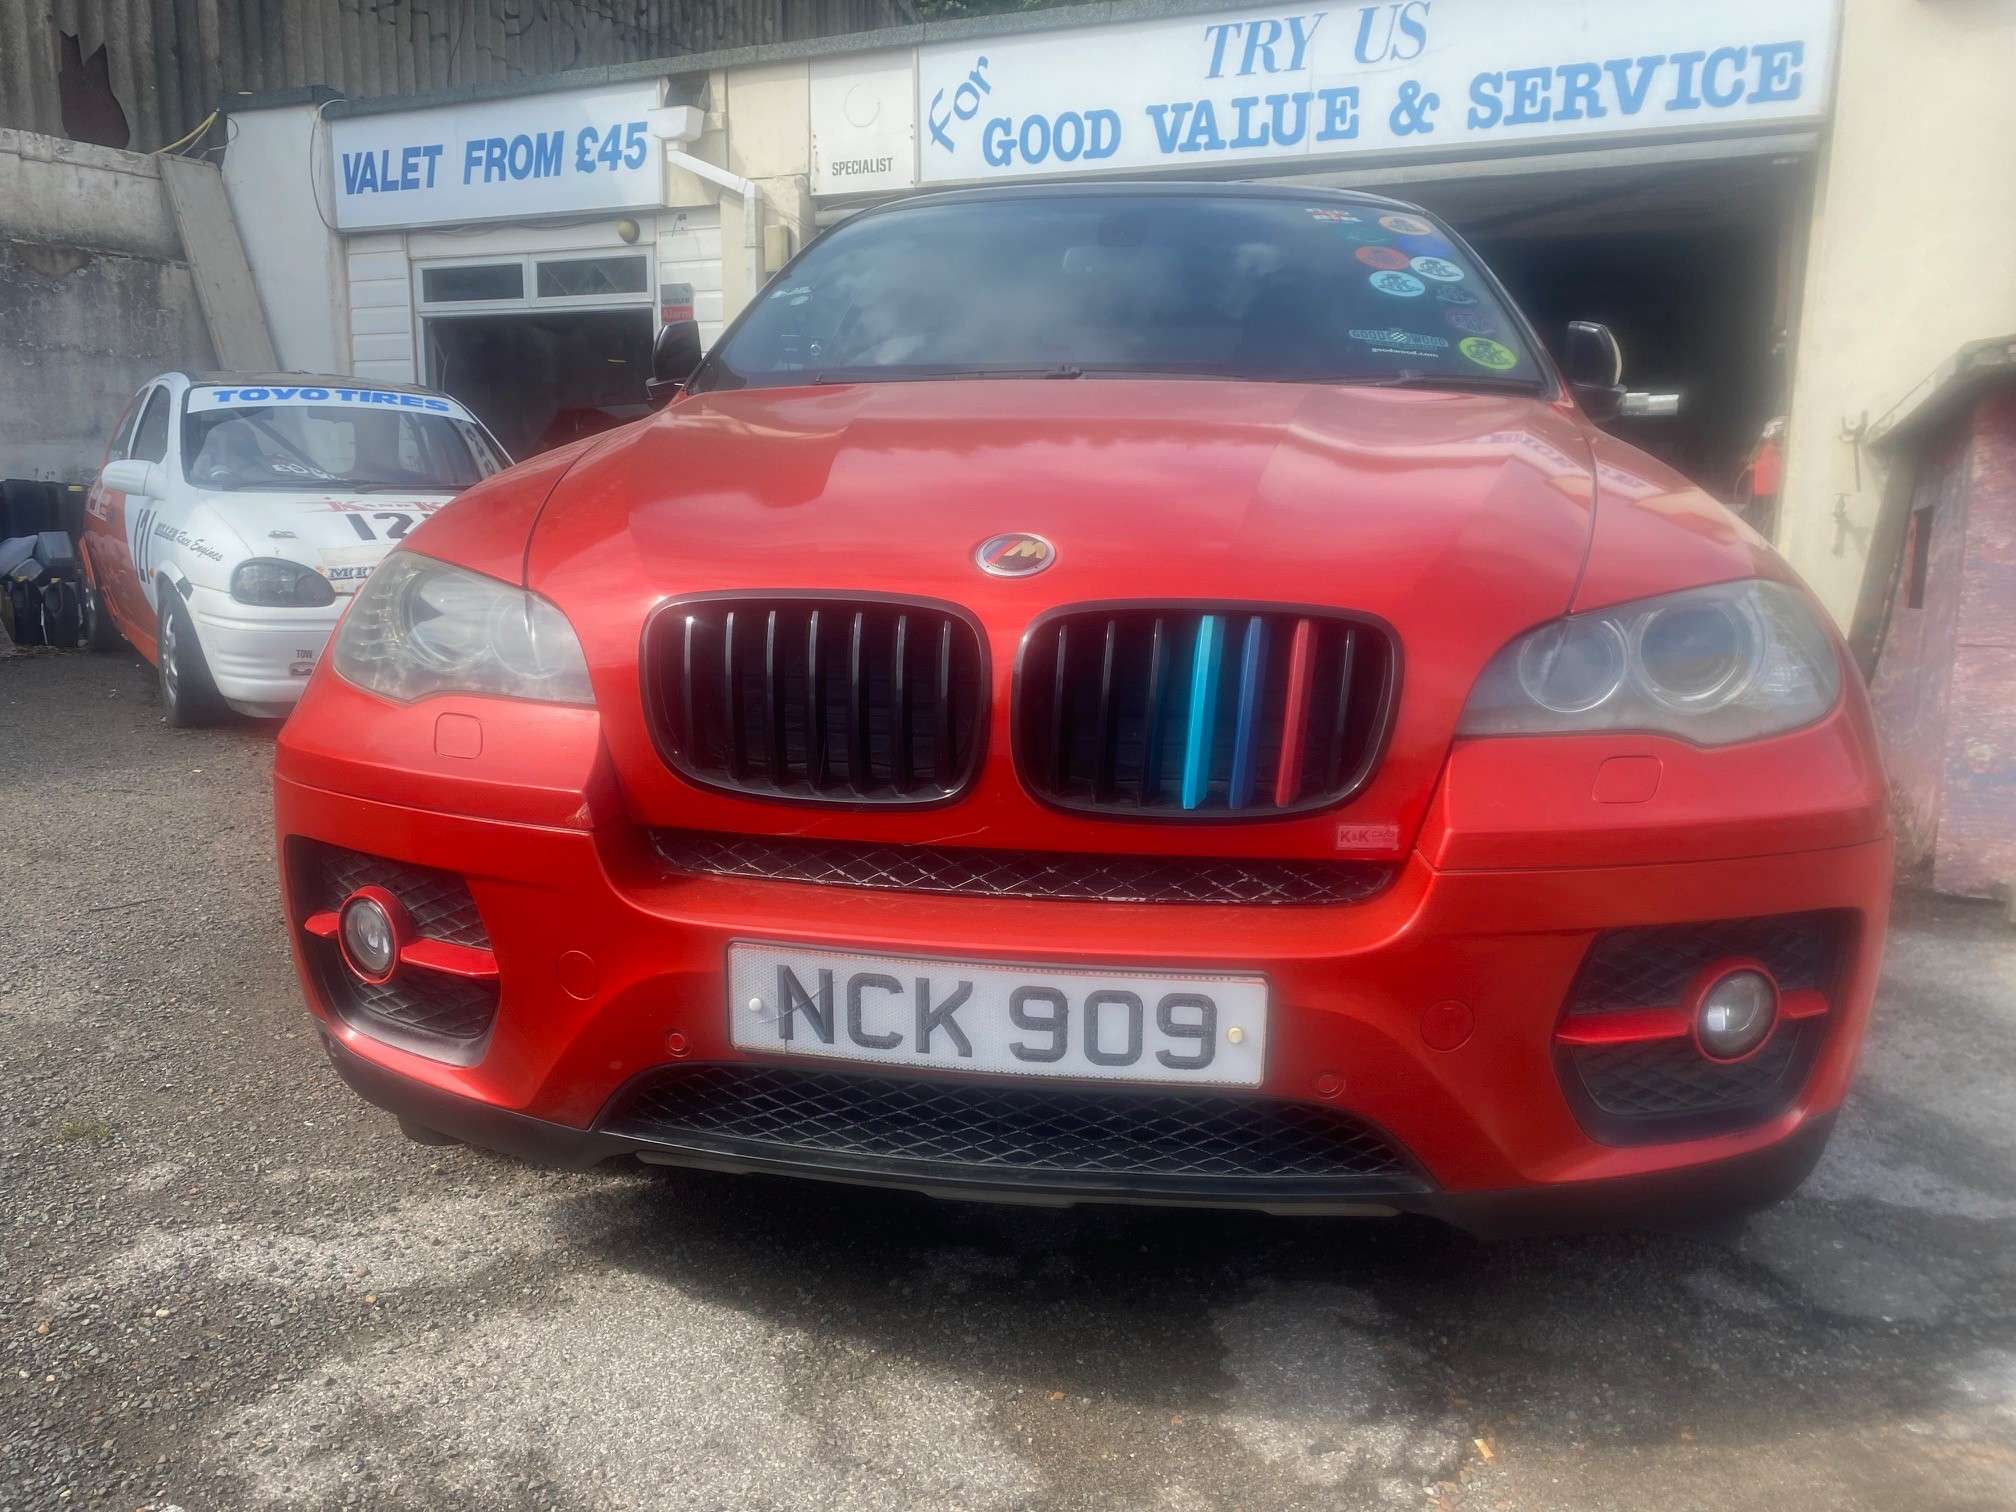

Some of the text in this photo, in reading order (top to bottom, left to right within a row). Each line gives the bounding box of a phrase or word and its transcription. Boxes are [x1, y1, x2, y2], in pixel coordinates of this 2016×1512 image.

[1203, 1, 1431, 79] TRY US
[982, 41, 1804, 167] GOOD VALUE & SERVICE
[341, 121, 648, 196] VALET FROM £45
[831, 158, 894, 177] SPECIALIST
[213, 386, 450, 413] TOYO TIRES
[344, 512, 432, 540] 12
[295, 648, 313, 659] TOW
[776, 964, 1218, 1070] NCK 909
